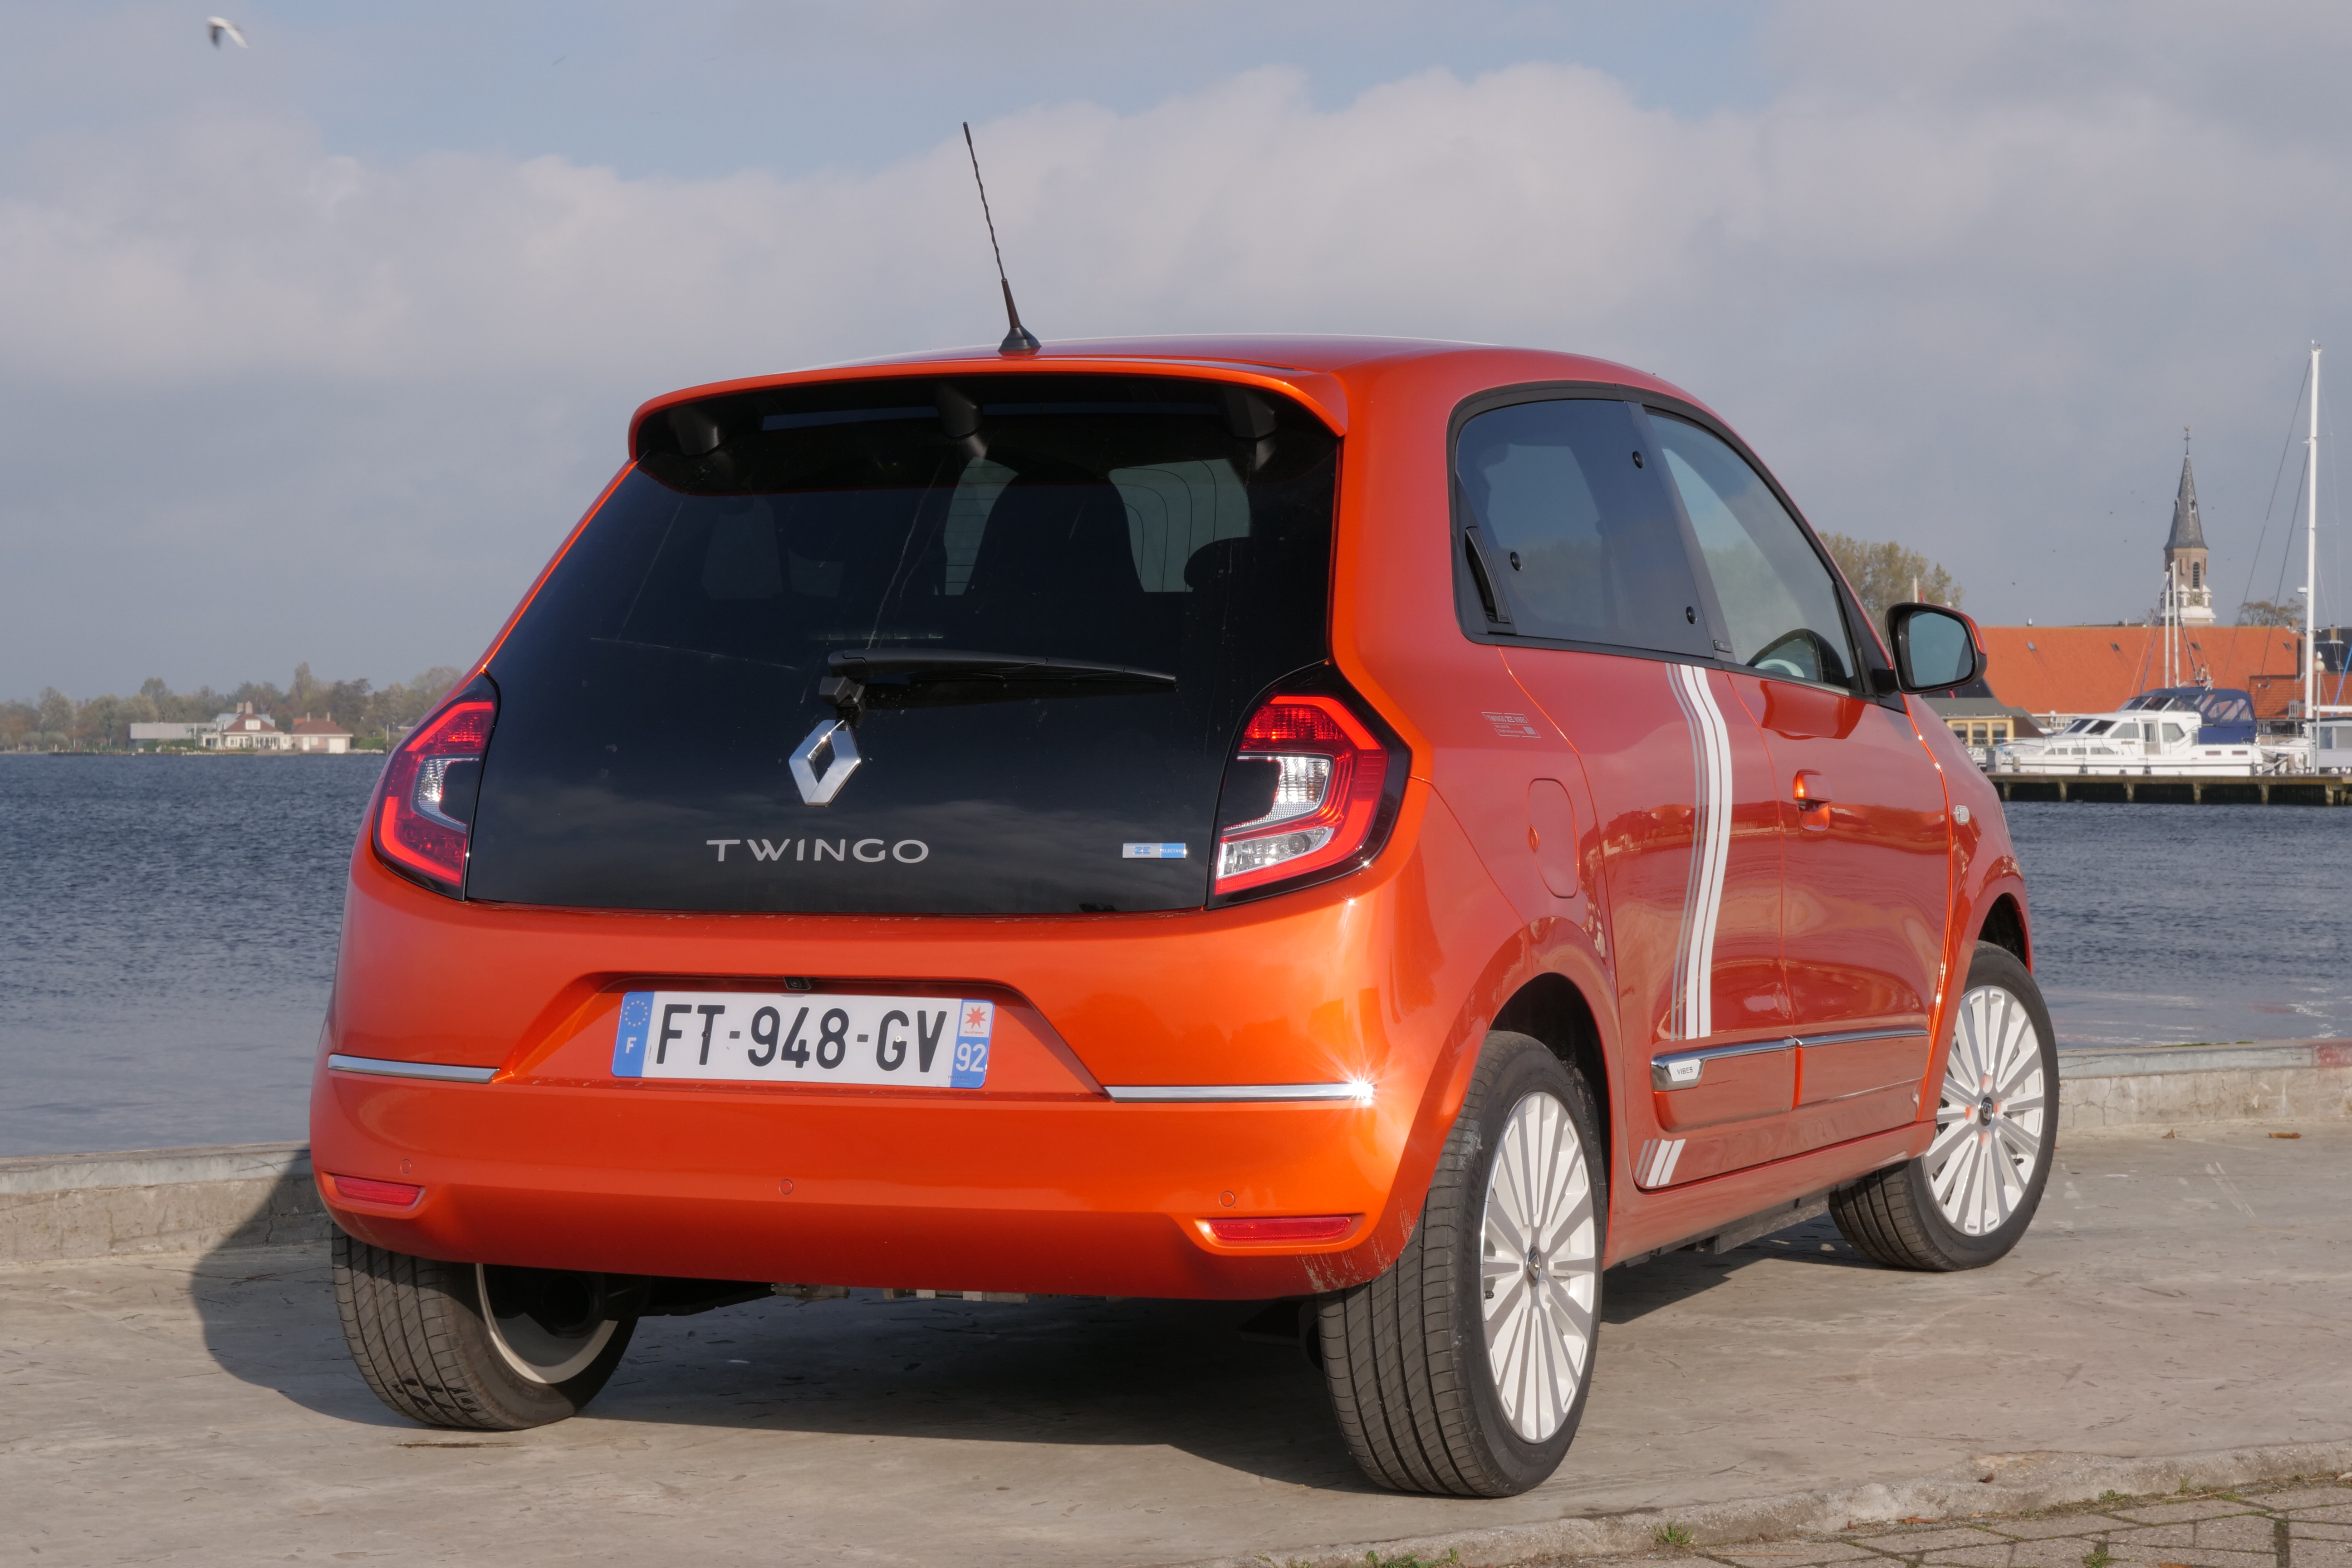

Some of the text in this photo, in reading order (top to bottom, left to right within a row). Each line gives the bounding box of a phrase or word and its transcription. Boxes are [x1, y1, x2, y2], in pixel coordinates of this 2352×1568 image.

[706, 839, 929, 863] TWINGO
[625, 1037, 637, 1054] F
[657, 1004, 947, 1073] FT-948-GV
[956, 1043, 986, 1072] 92
[1677, 1067, 1693, 1075] VIBES
